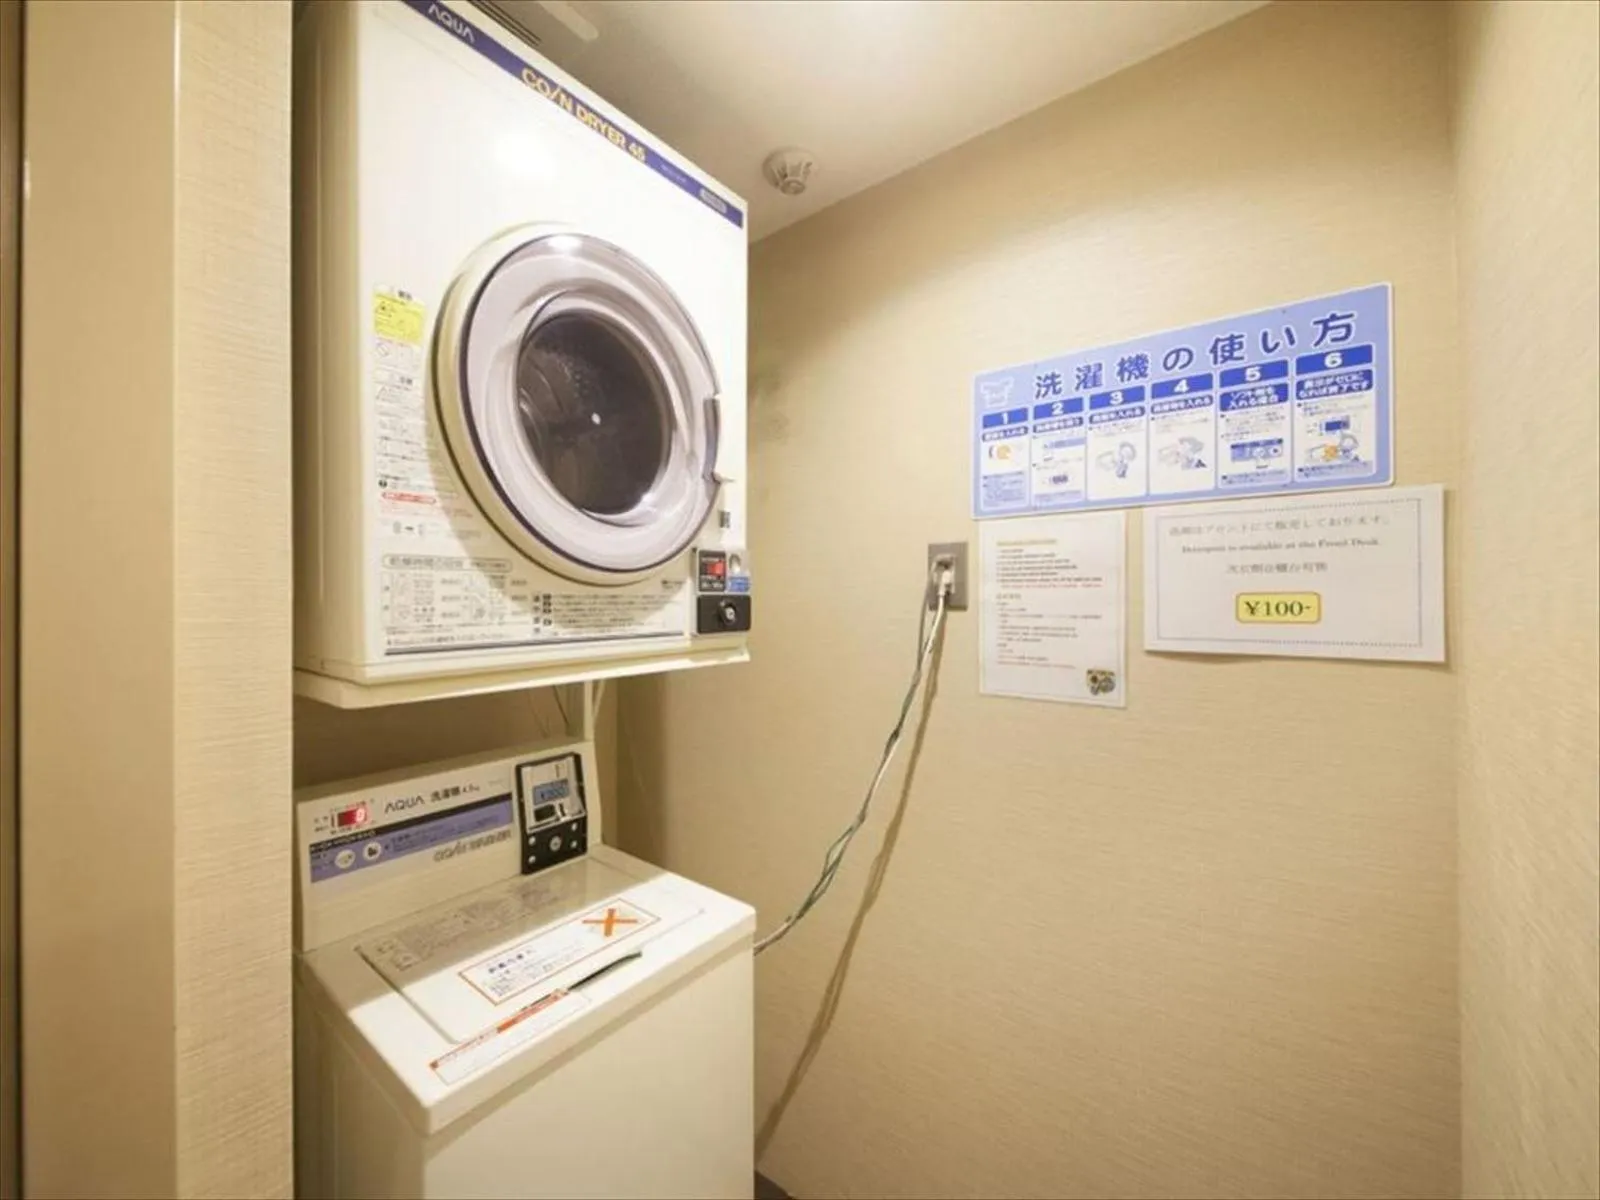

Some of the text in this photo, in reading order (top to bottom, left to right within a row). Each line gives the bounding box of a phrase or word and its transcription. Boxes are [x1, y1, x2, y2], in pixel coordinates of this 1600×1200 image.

[428, 2, 475, 44] AQUA
[575, 104, 627, 150] DRYER
[1035, 311, 1355, 399] 洗濯機の使い方
[1323, 352, 1343, 369] 6
[1244, 365, 1262, 382] 5
[1173, 378, 1190, 393] 4
[1109, 390, 1124, 406] 3
[1051, 402, 1064, 416] 2
[1001, 411, 1009, 425] 1
[384, 794, 426, 815] AQUA
